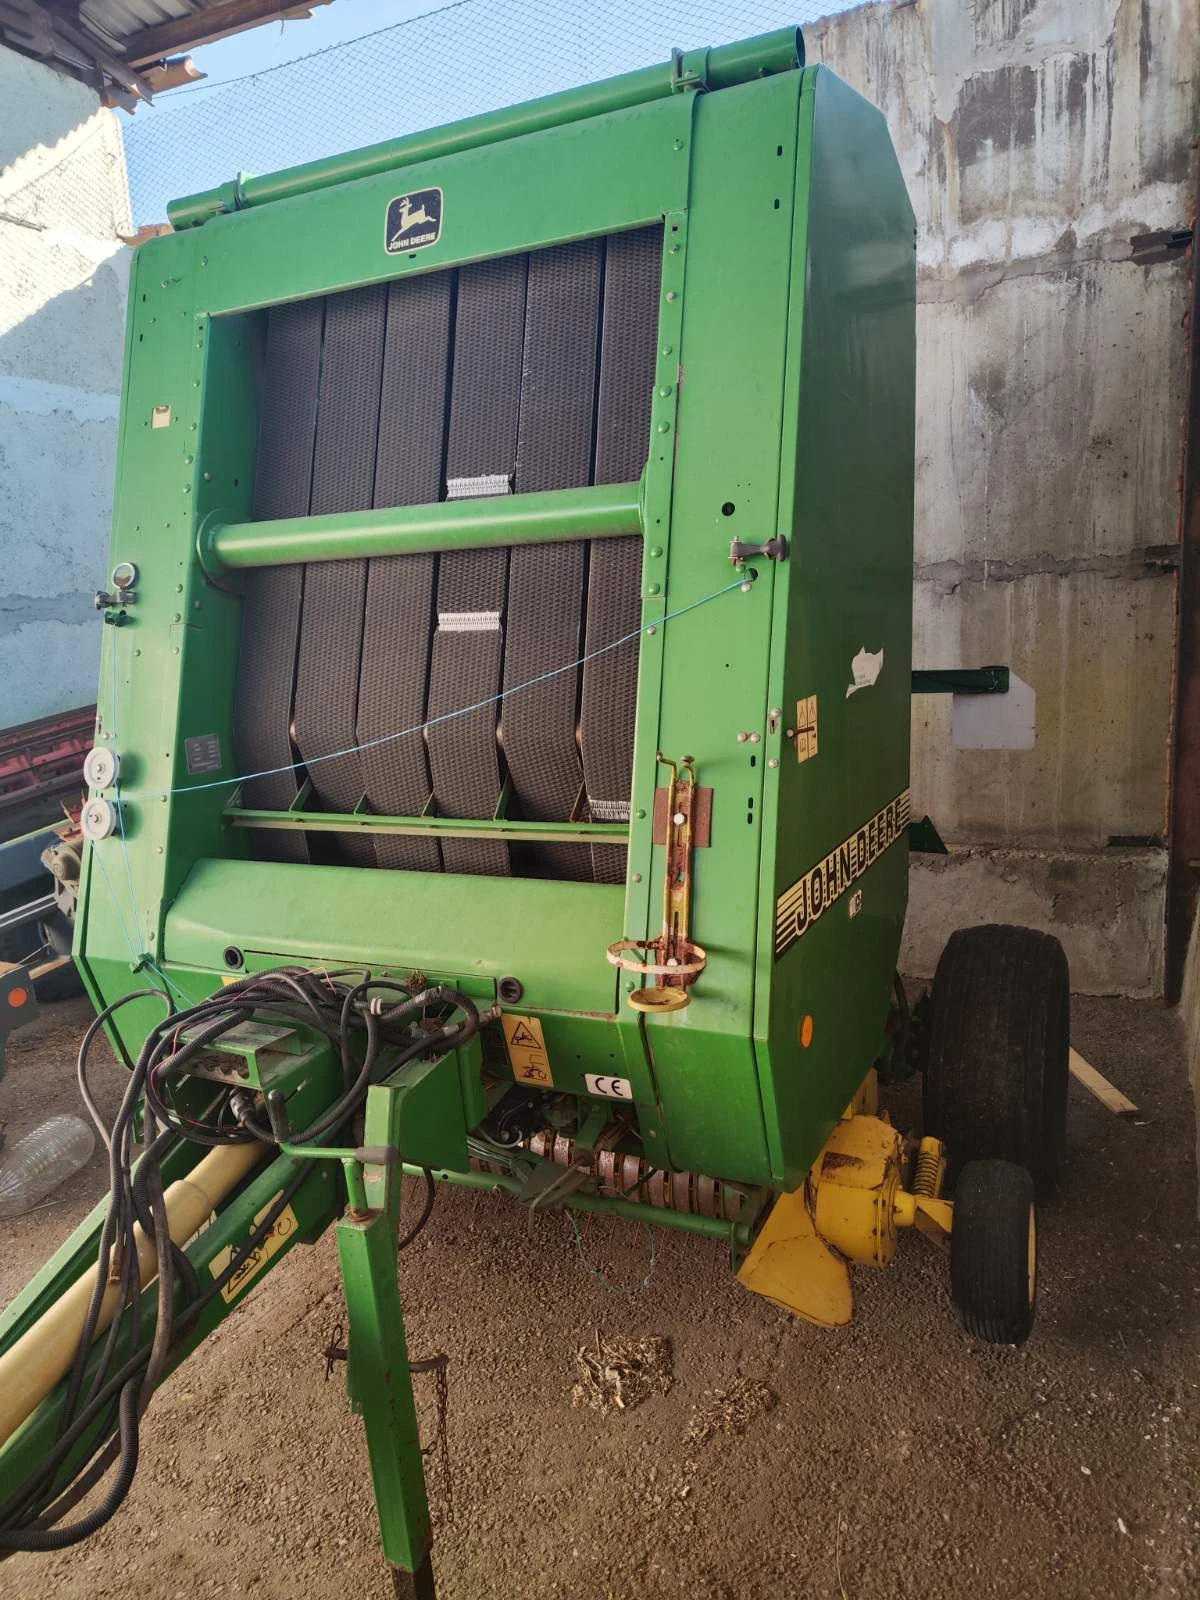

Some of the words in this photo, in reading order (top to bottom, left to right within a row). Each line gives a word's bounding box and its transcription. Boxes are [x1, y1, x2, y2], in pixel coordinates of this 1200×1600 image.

[388, 238, 409, 250] JOHN
[410, 232, 436, 245] DEERE
[796, 842, 852, 935] JOHN
[856, 797, 903, 875] DEERE
[595, 1077, 624, 1096] CE
